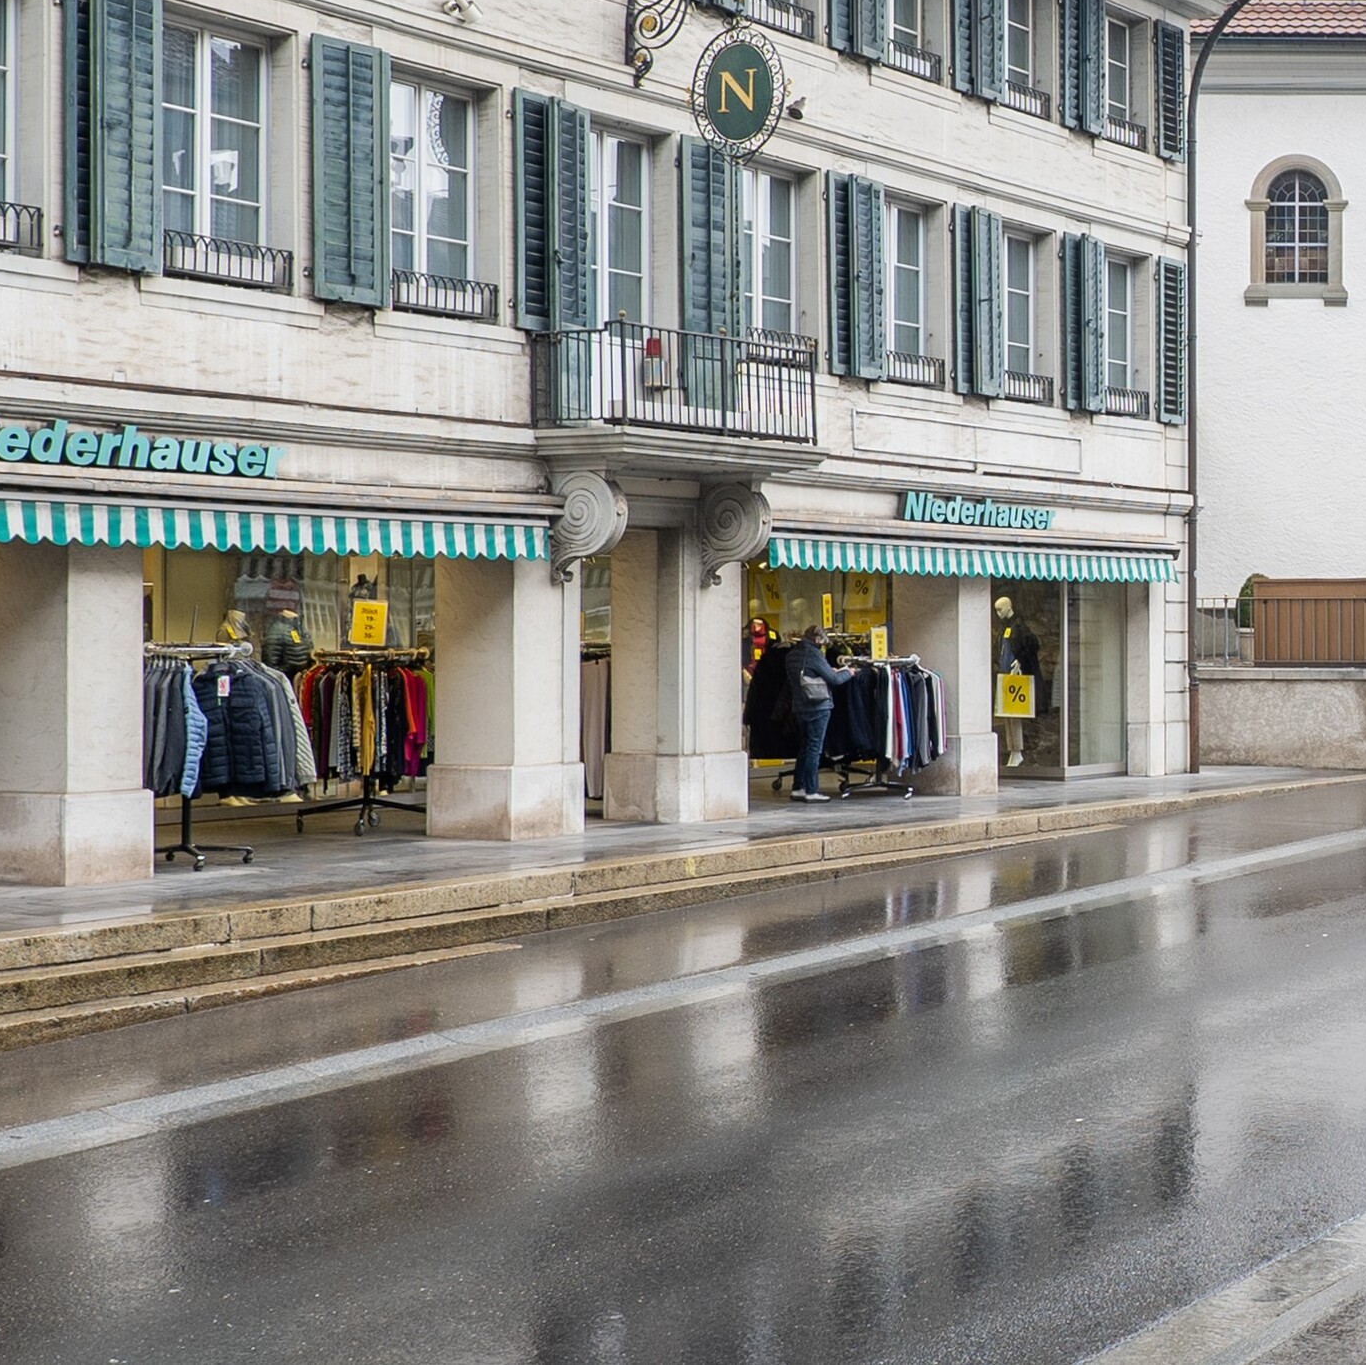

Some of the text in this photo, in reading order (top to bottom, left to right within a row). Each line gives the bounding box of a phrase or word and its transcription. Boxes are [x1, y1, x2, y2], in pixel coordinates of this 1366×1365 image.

[717, 69, 757, 113] N
[904, 491, 1056, 530] Niederhauser
[1008, 685, 1026, 703] %
